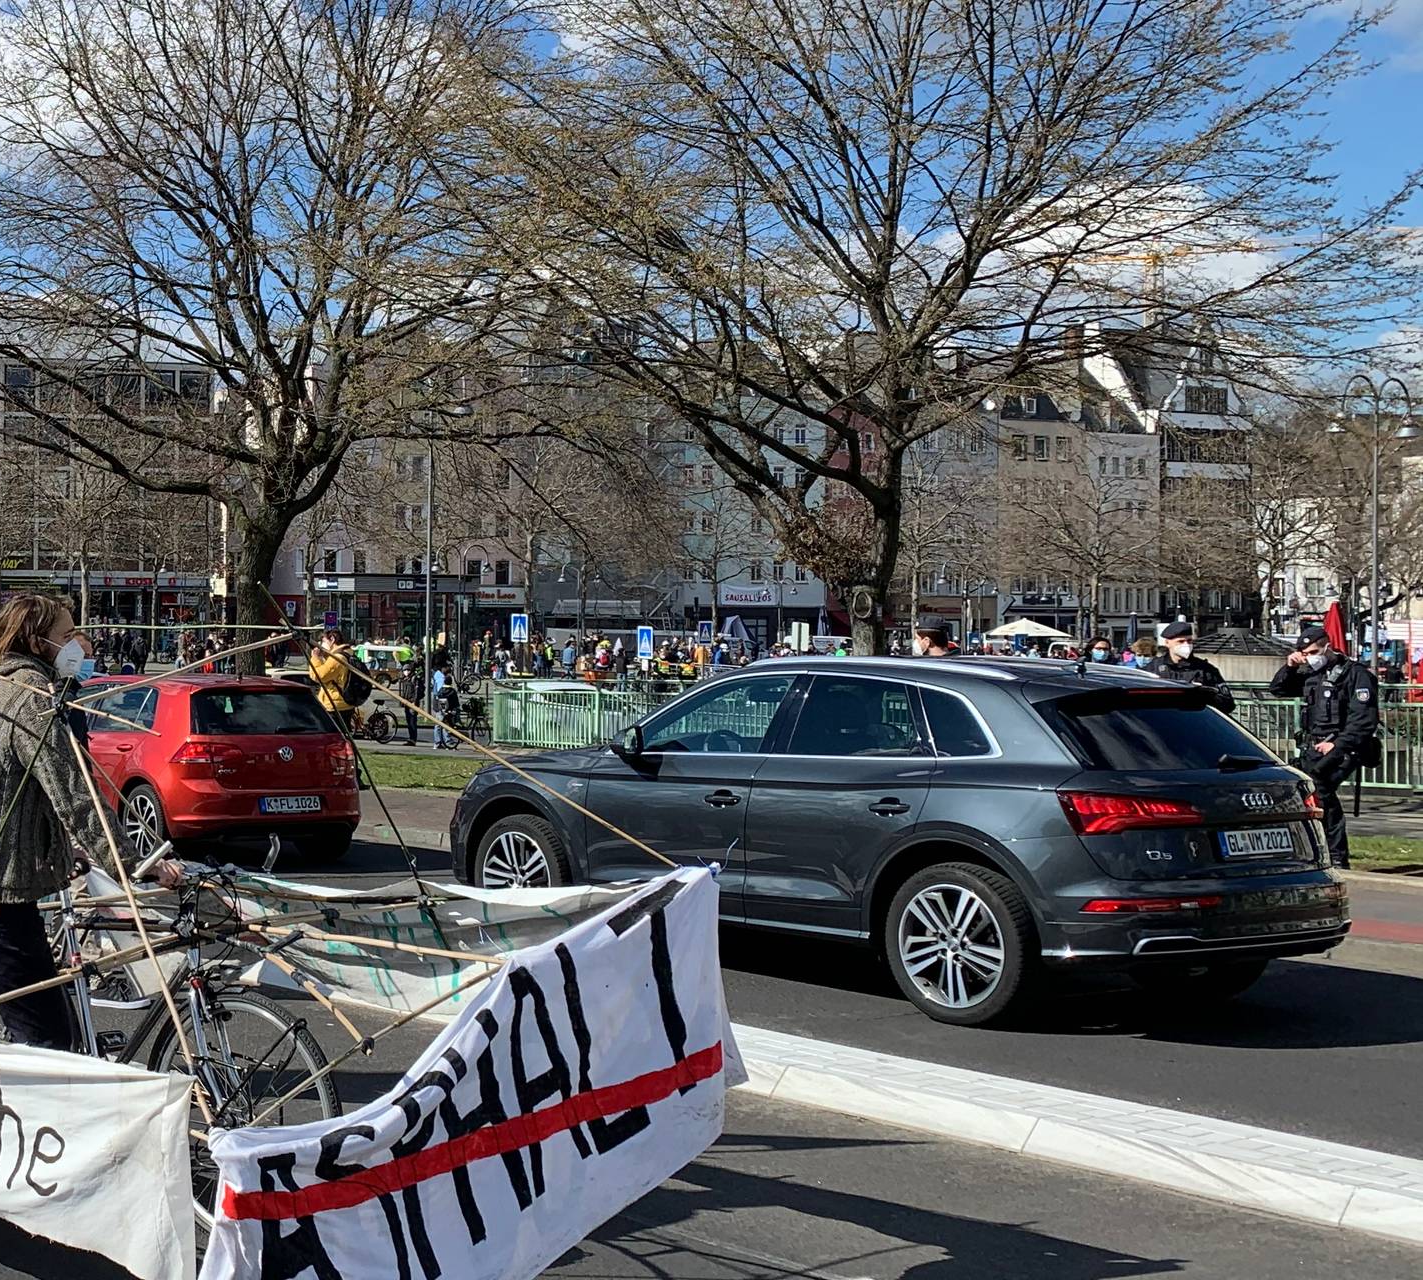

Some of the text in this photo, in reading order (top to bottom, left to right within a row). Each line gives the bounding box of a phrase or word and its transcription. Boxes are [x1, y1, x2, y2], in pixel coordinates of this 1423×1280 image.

[266, 796, 319, 810] K FL 1026
[1227, 830, 1292, 852] GL VM 2021
[1146, 849, 1173, 860] Q5
[260, 880, 697, 1280] ASPHALT
